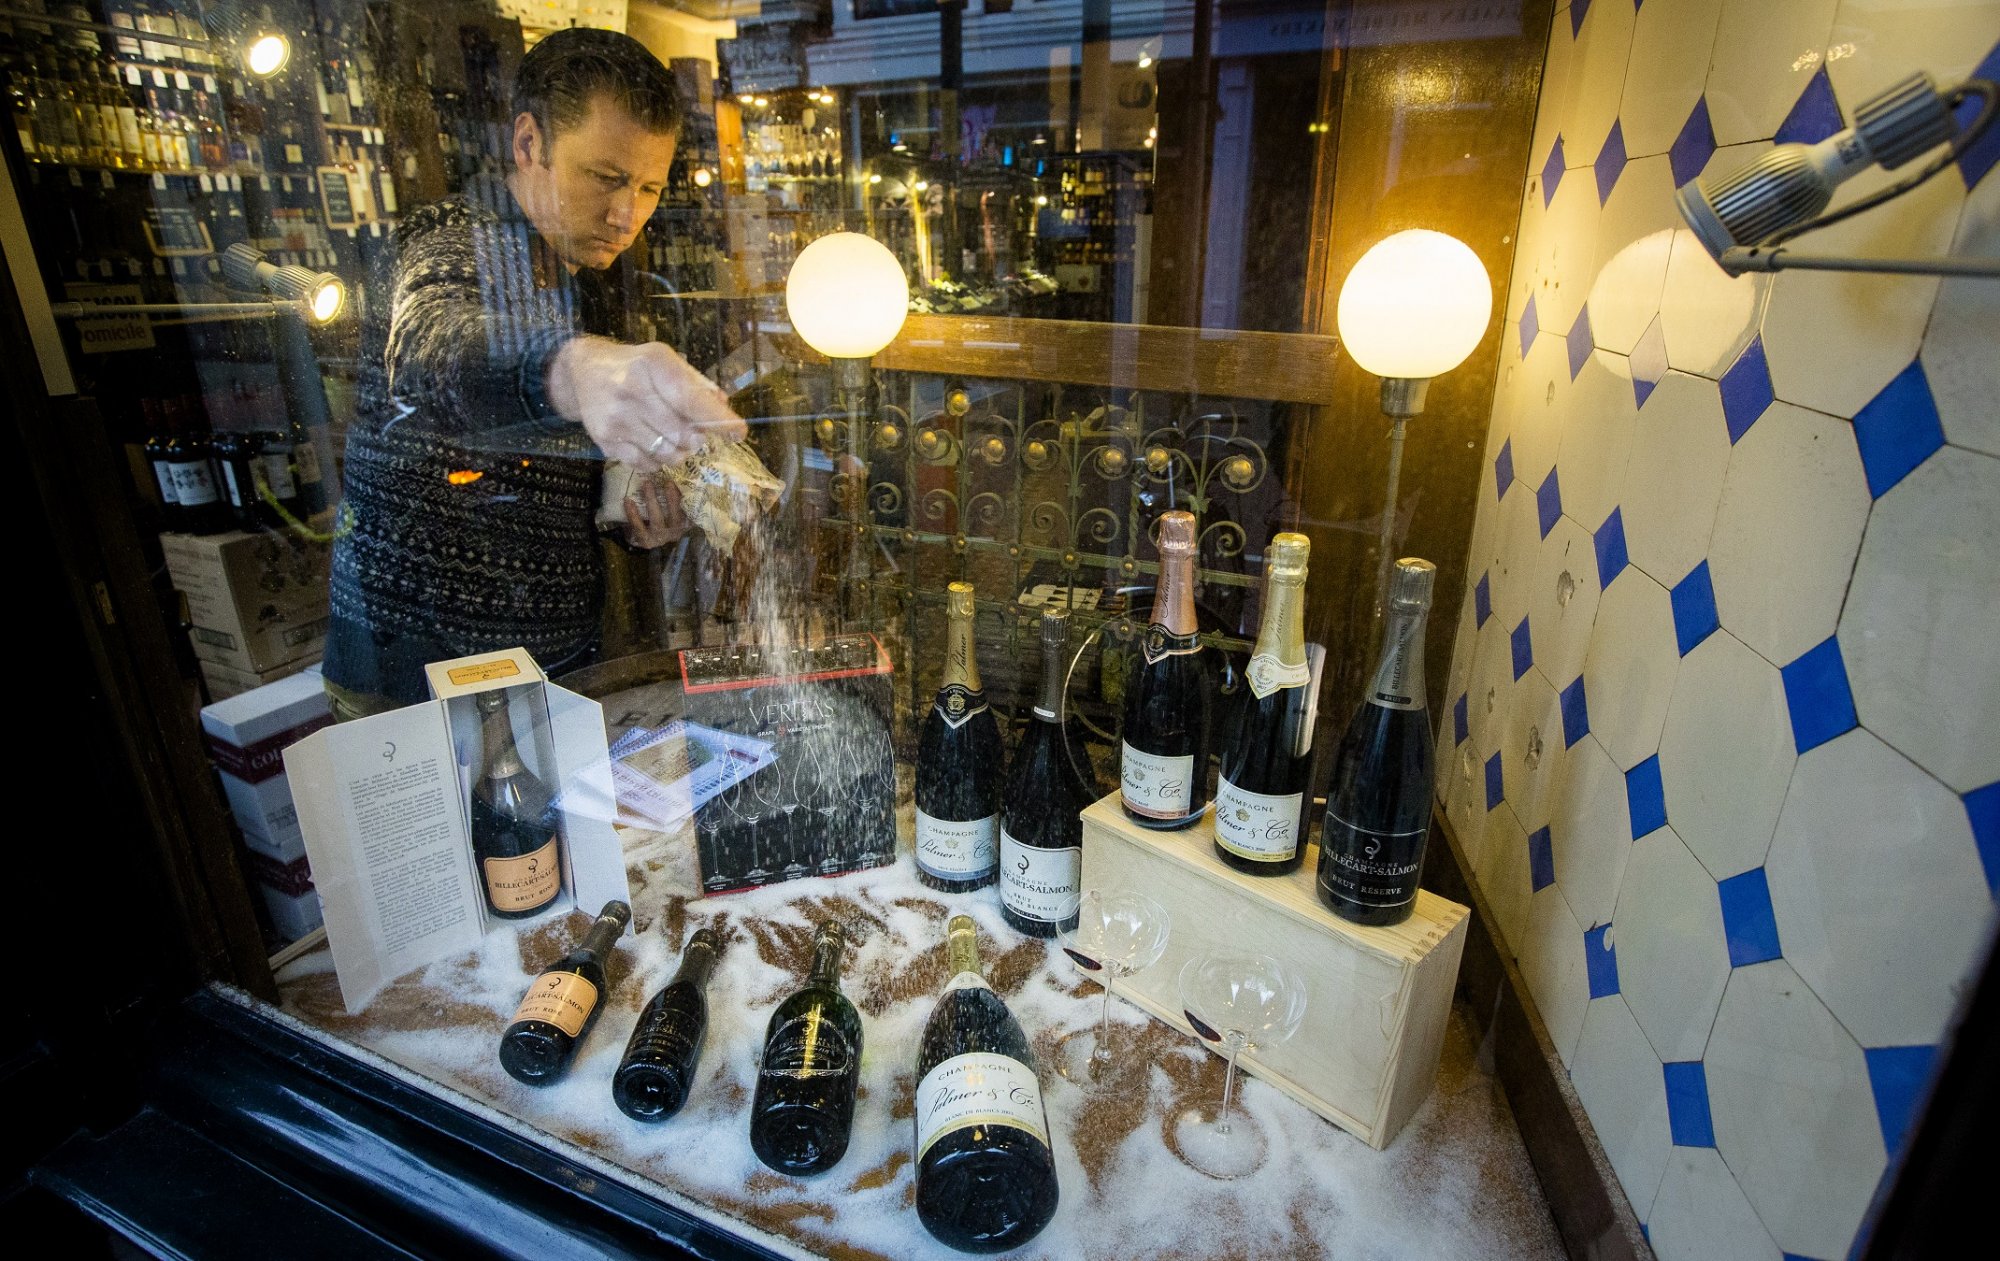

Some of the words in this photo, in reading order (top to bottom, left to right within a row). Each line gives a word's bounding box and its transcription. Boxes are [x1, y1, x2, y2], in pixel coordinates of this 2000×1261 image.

[749, 699, 835, 726] VERITAS
[1124, 751, 1166, 772] CHAMPAGNE
[1143, 787, 1157, 797] &
[1222, 791, 1276, 812] CHAMPAGNE
[1217, 800, 1245, 831] Palmer
[1247, 827, 1263, 839] &
[928, 826, 979, 837] CHAMPAGNE
[920, 838, 956, 859] Palmer
[957, 850, 971, 862] &
[1325, 845, 1419, 876] BILLECART-SALMON
[1344, 853, 1399, 868] CHAMPAGNE
[1332, 873, 1356, 890] BRUT
[920, 1083, 982, 1131] Palmer
[987, 1089, 1005, 1101] &
